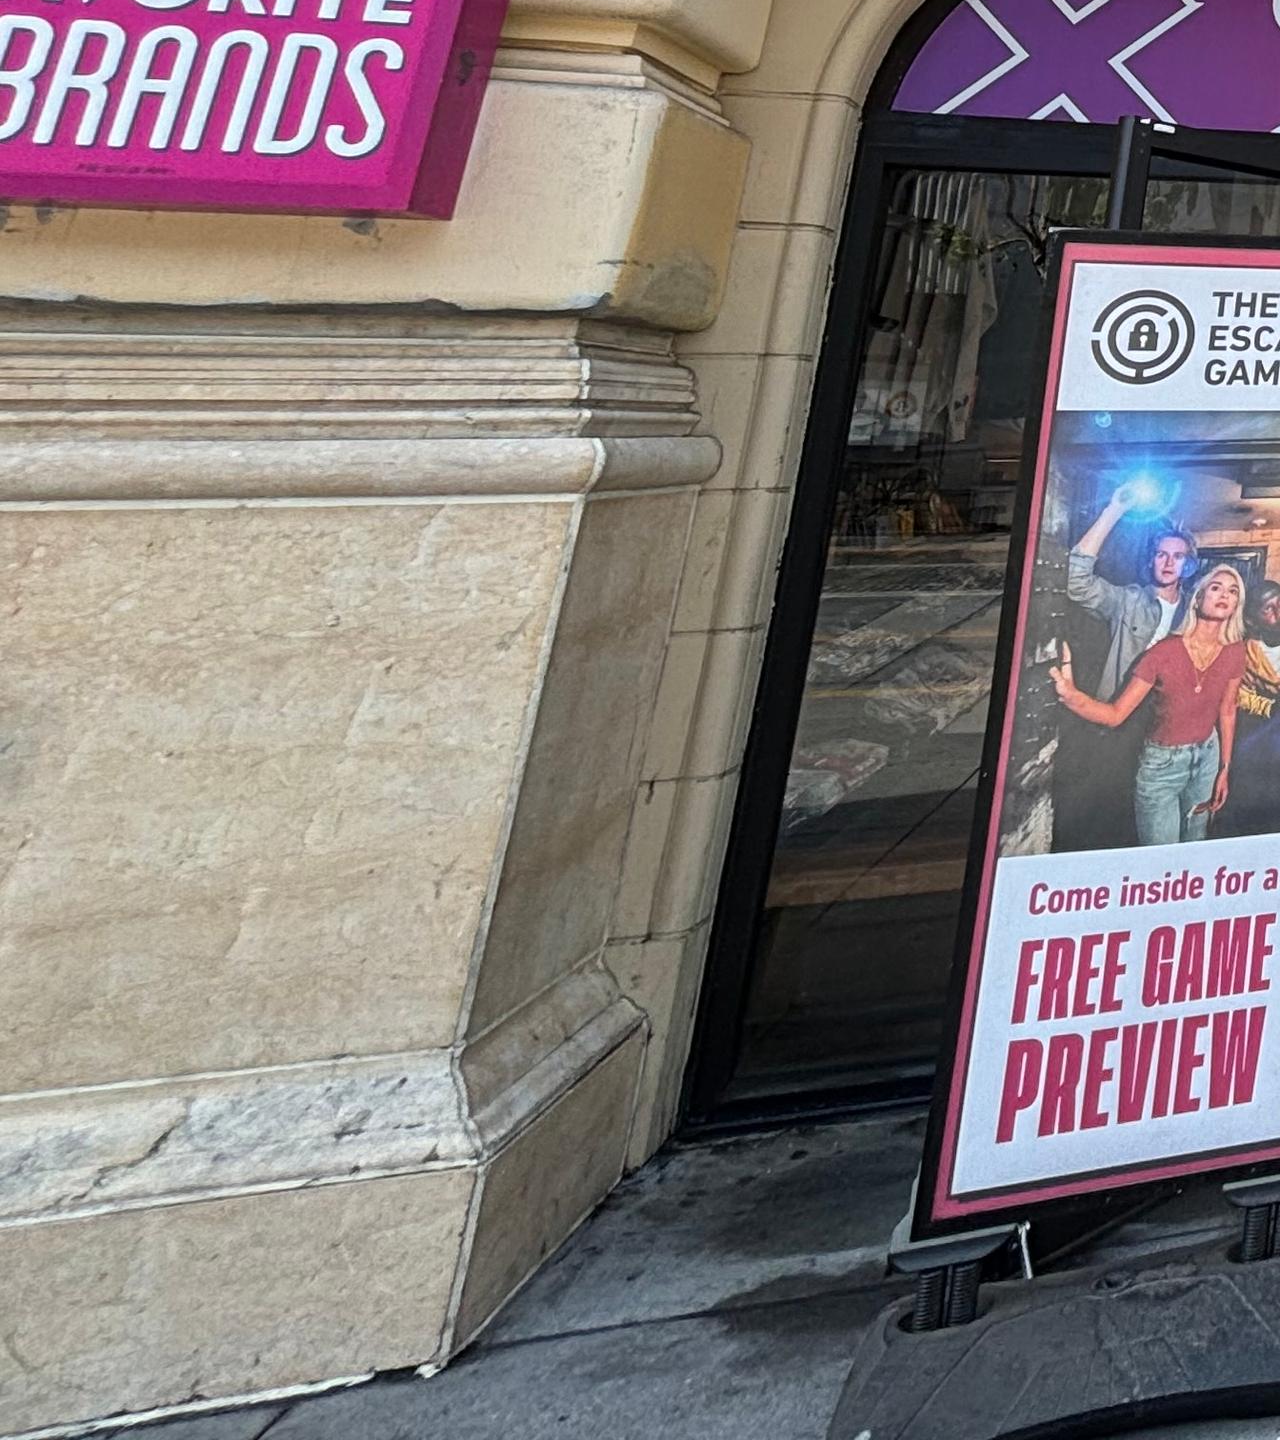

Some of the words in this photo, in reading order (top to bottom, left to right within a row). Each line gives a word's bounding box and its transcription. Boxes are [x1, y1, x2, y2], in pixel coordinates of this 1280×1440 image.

[0, 15, 403, 157] BRANDS
[1212, 291, 1280, 319] THE
[1029, 883, 1110, 915] Come
[1119, 868, 1204, 907] inside
[1214, 865, 1255, 895] for
[1262, 867, 1279, 890] a
[1010, 930, 1131, 1025] FREE
[1141, 912, 1277, 1008] GAME
[995, 1005, 1267, 1144] PREVIEW
